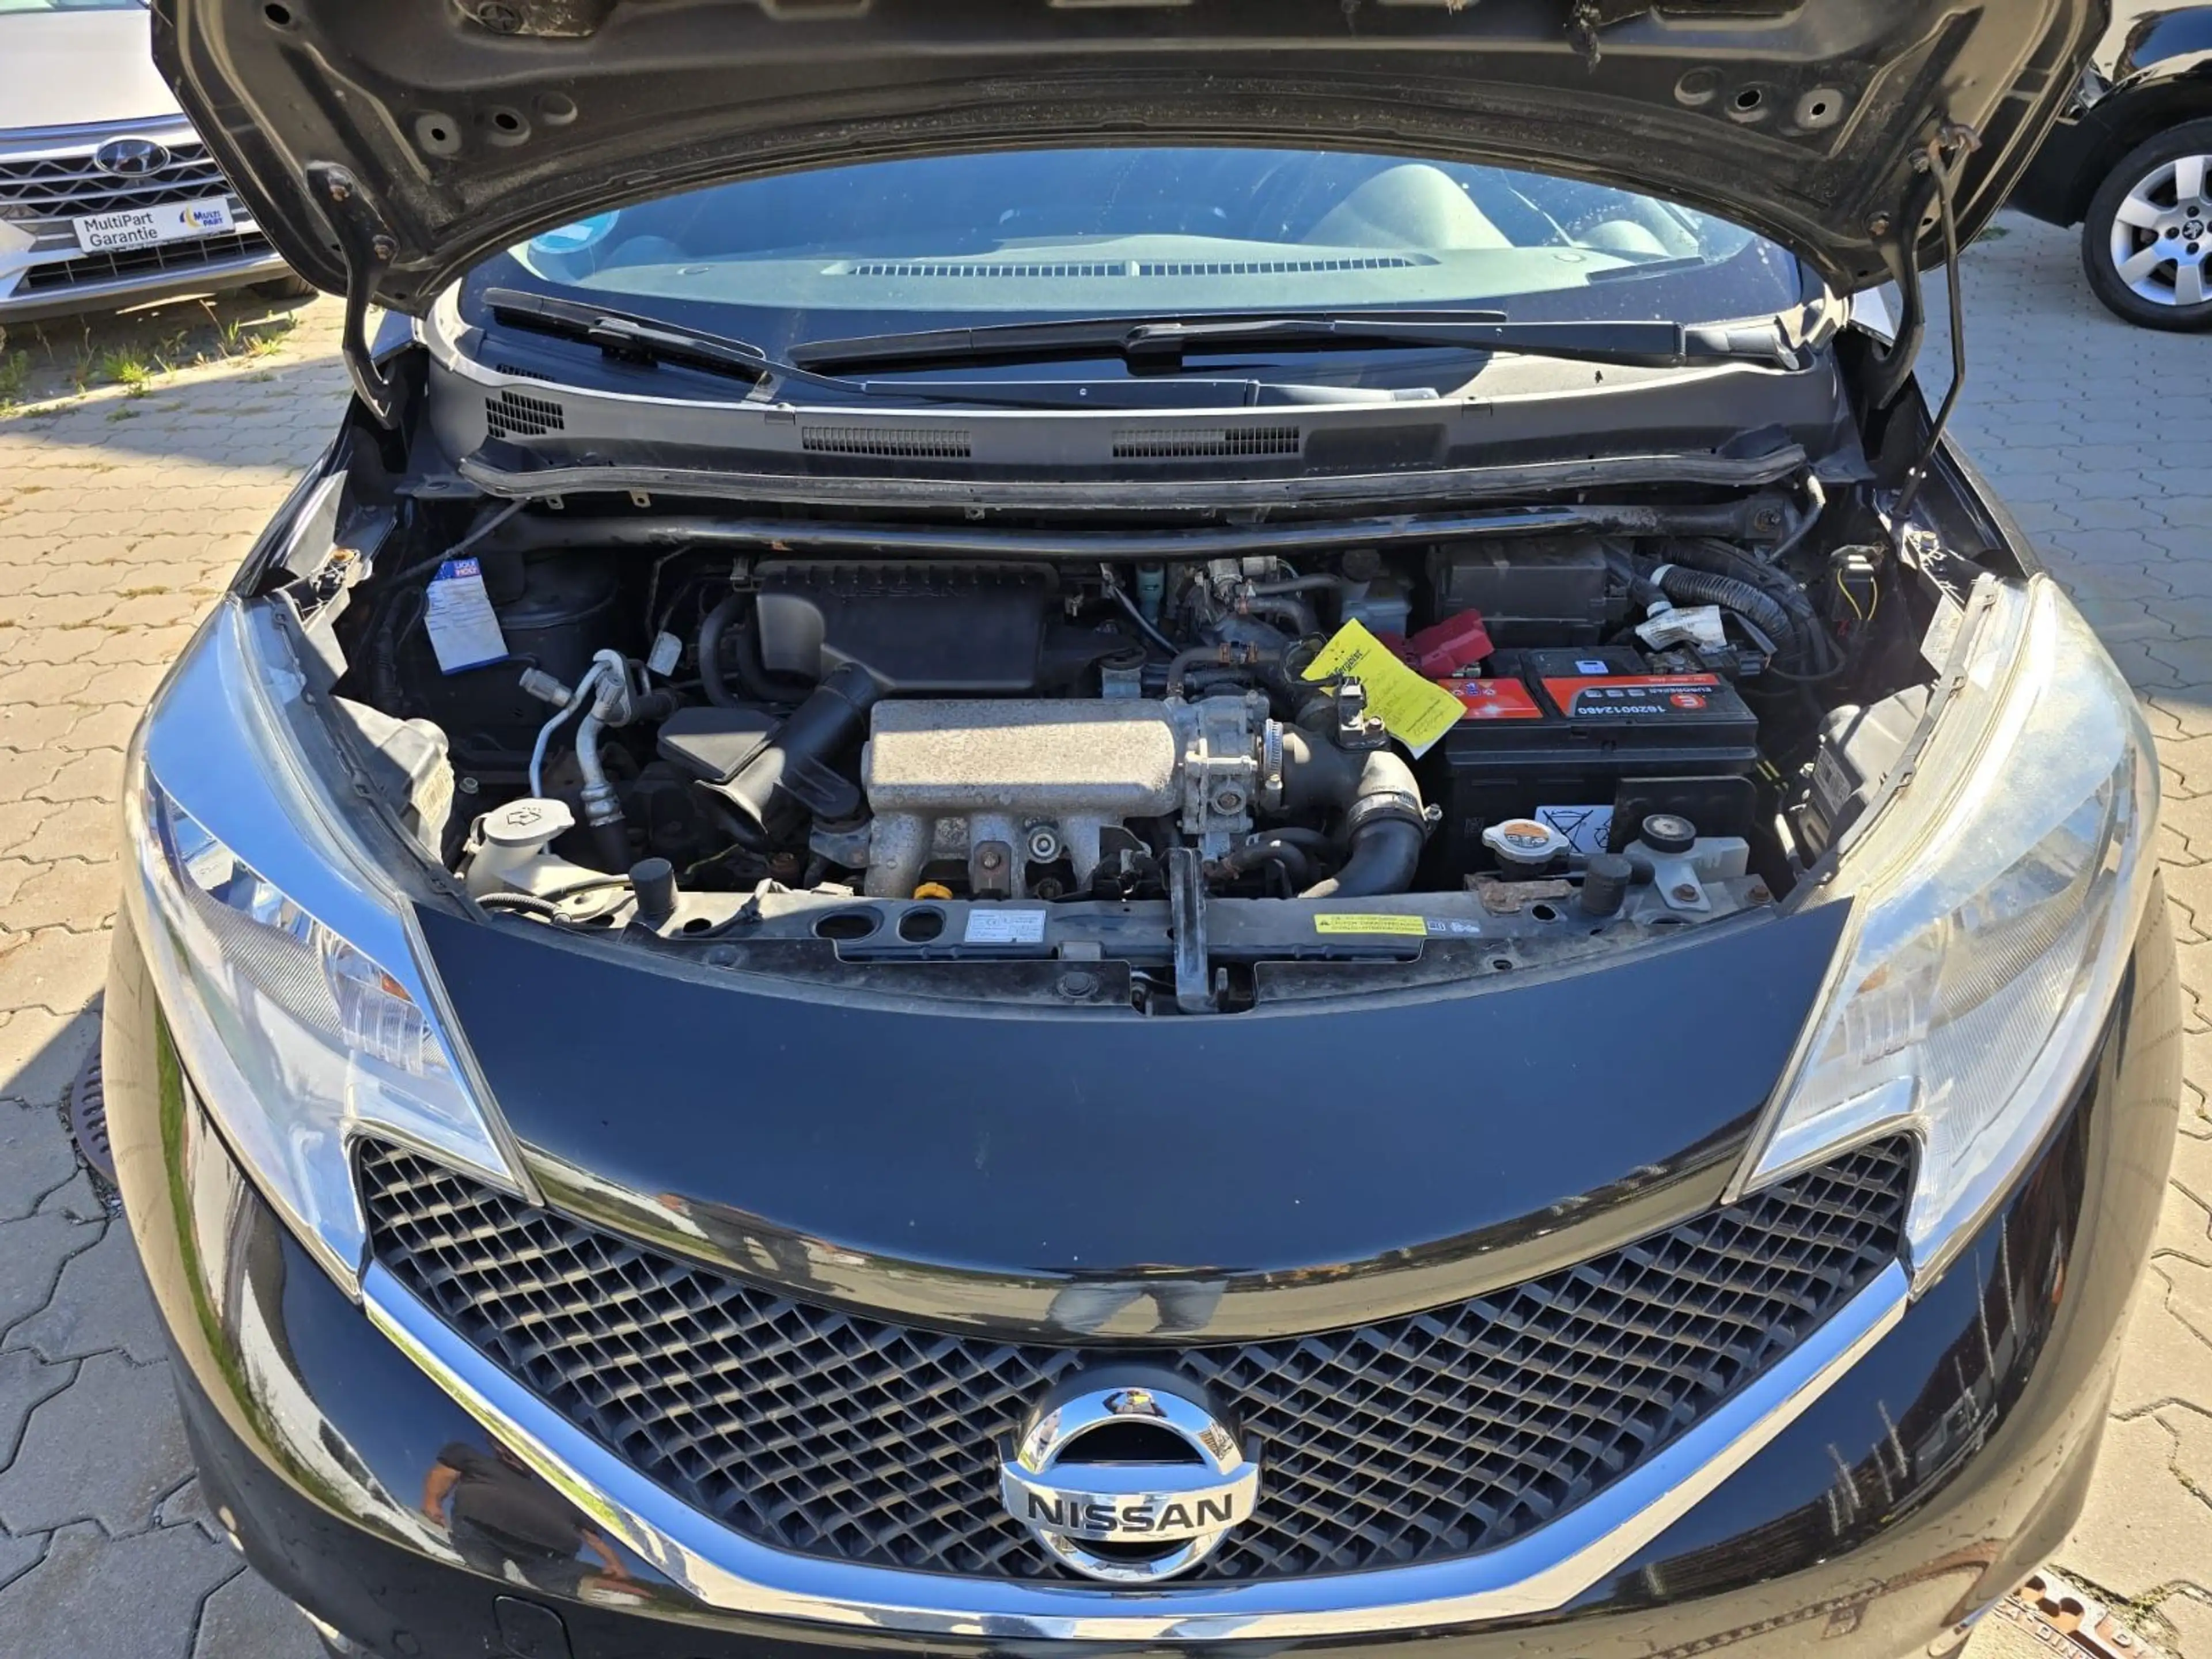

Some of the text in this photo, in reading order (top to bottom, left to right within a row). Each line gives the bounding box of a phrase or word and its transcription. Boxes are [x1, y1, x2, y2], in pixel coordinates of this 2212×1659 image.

[84, 212, 154, 232] MultiPart
[89, 227, 158, 247] Garantie
[1028, 1493, 1233, 1533] NISSAN
